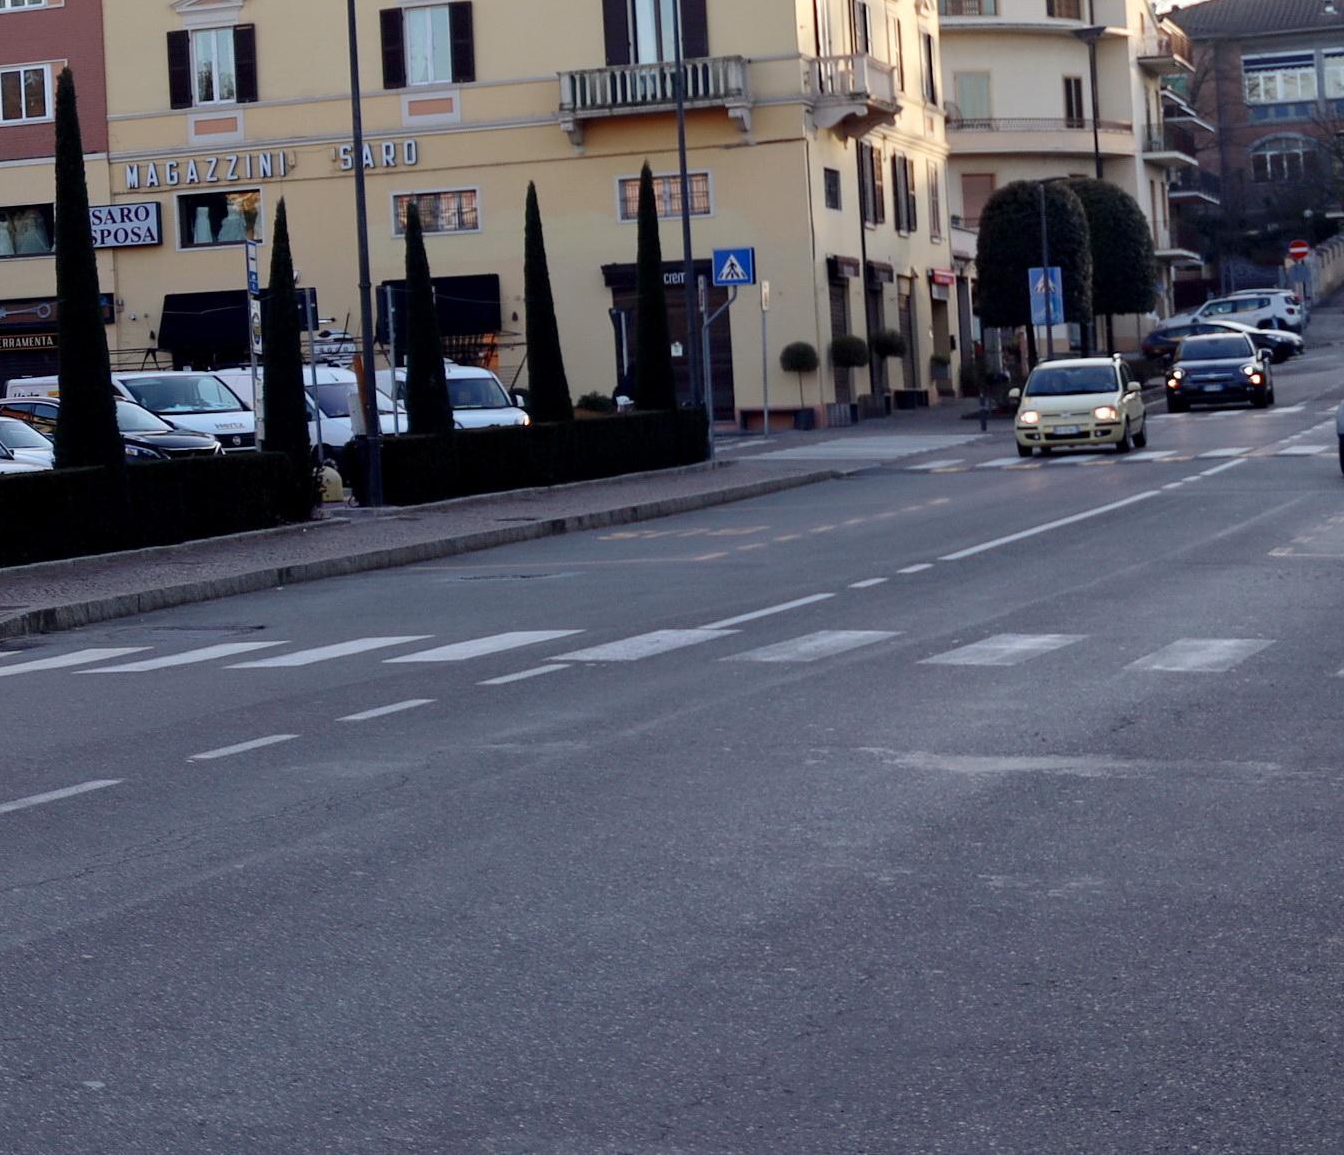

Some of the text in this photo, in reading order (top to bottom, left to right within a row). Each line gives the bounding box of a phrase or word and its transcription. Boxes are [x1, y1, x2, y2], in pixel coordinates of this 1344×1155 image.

[125, 138, 418, 189] MAGAZZINI SARO
[92, 205, 150, 226] SARO
